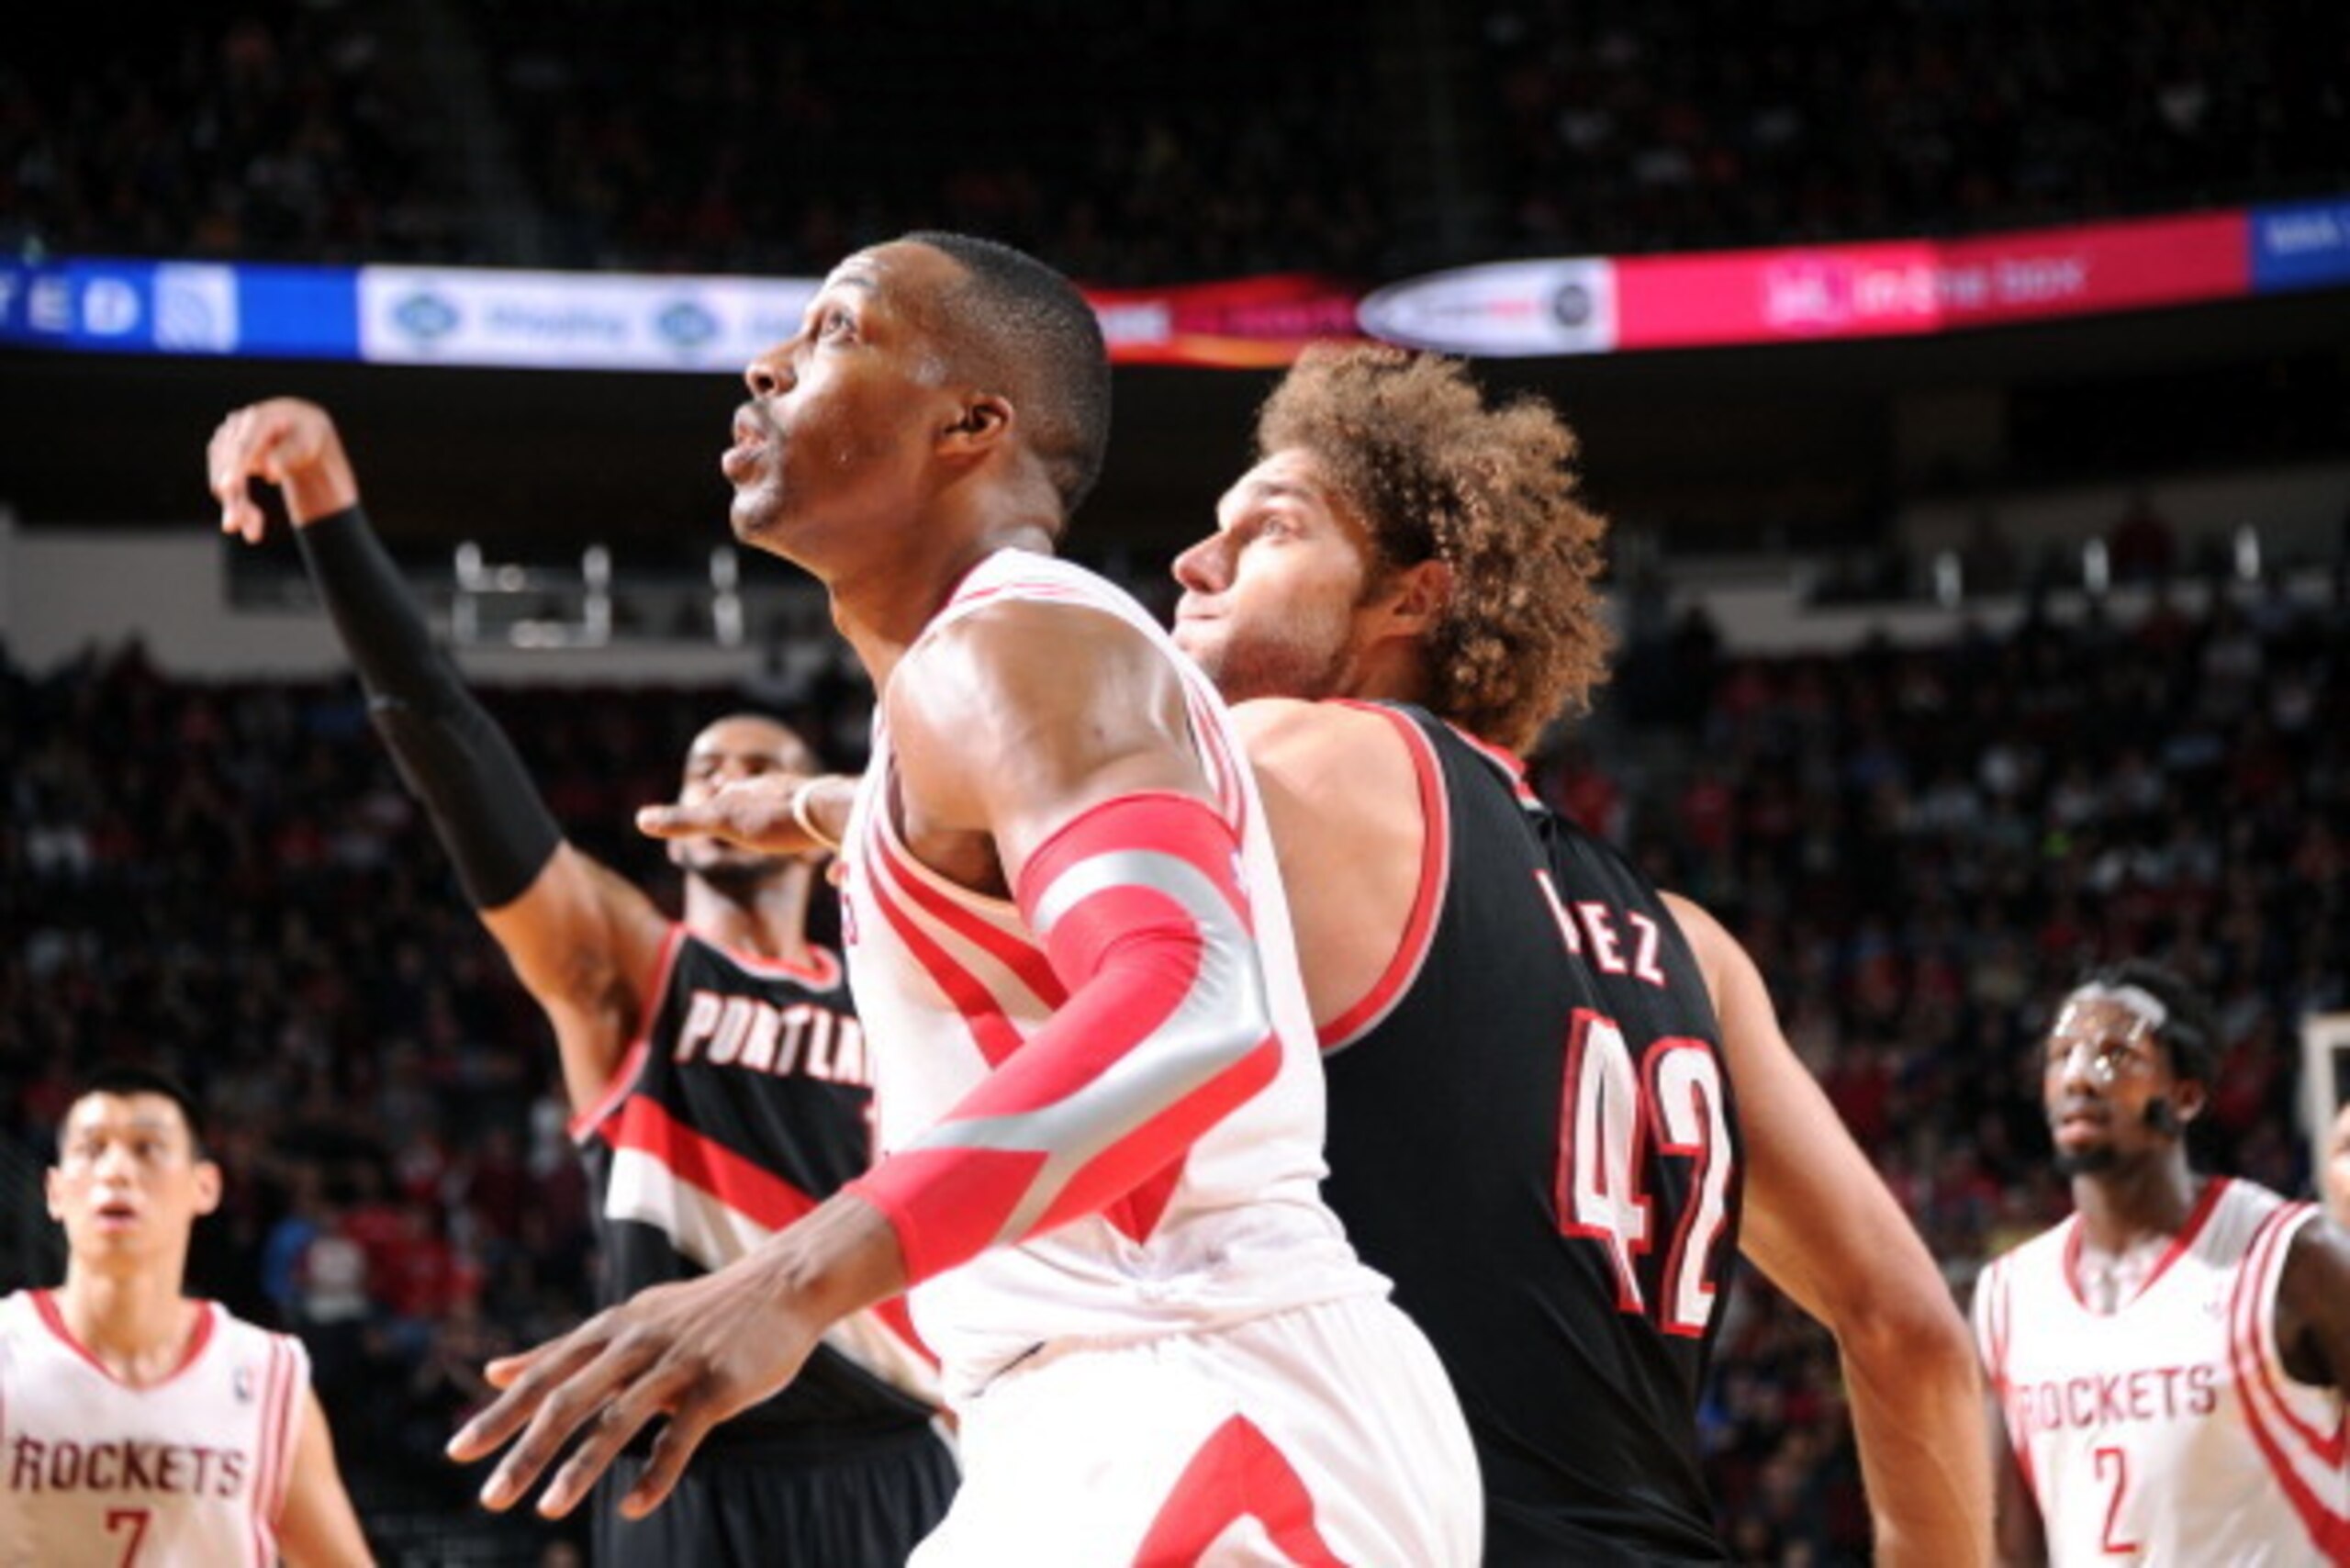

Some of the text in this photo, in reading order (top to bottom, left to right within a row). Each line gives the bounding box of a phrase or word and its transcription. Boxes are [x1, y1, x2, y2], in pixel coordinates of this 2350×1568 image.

[675, 989, 875, 1090] PORTLA
[1555, 1007, 1735, 1337] 42
[10, 1433, 248, 1498] ROCKETS
[2094, 1447, 2140, 1555] 2
[105, 1507, 151, 1568] 7
